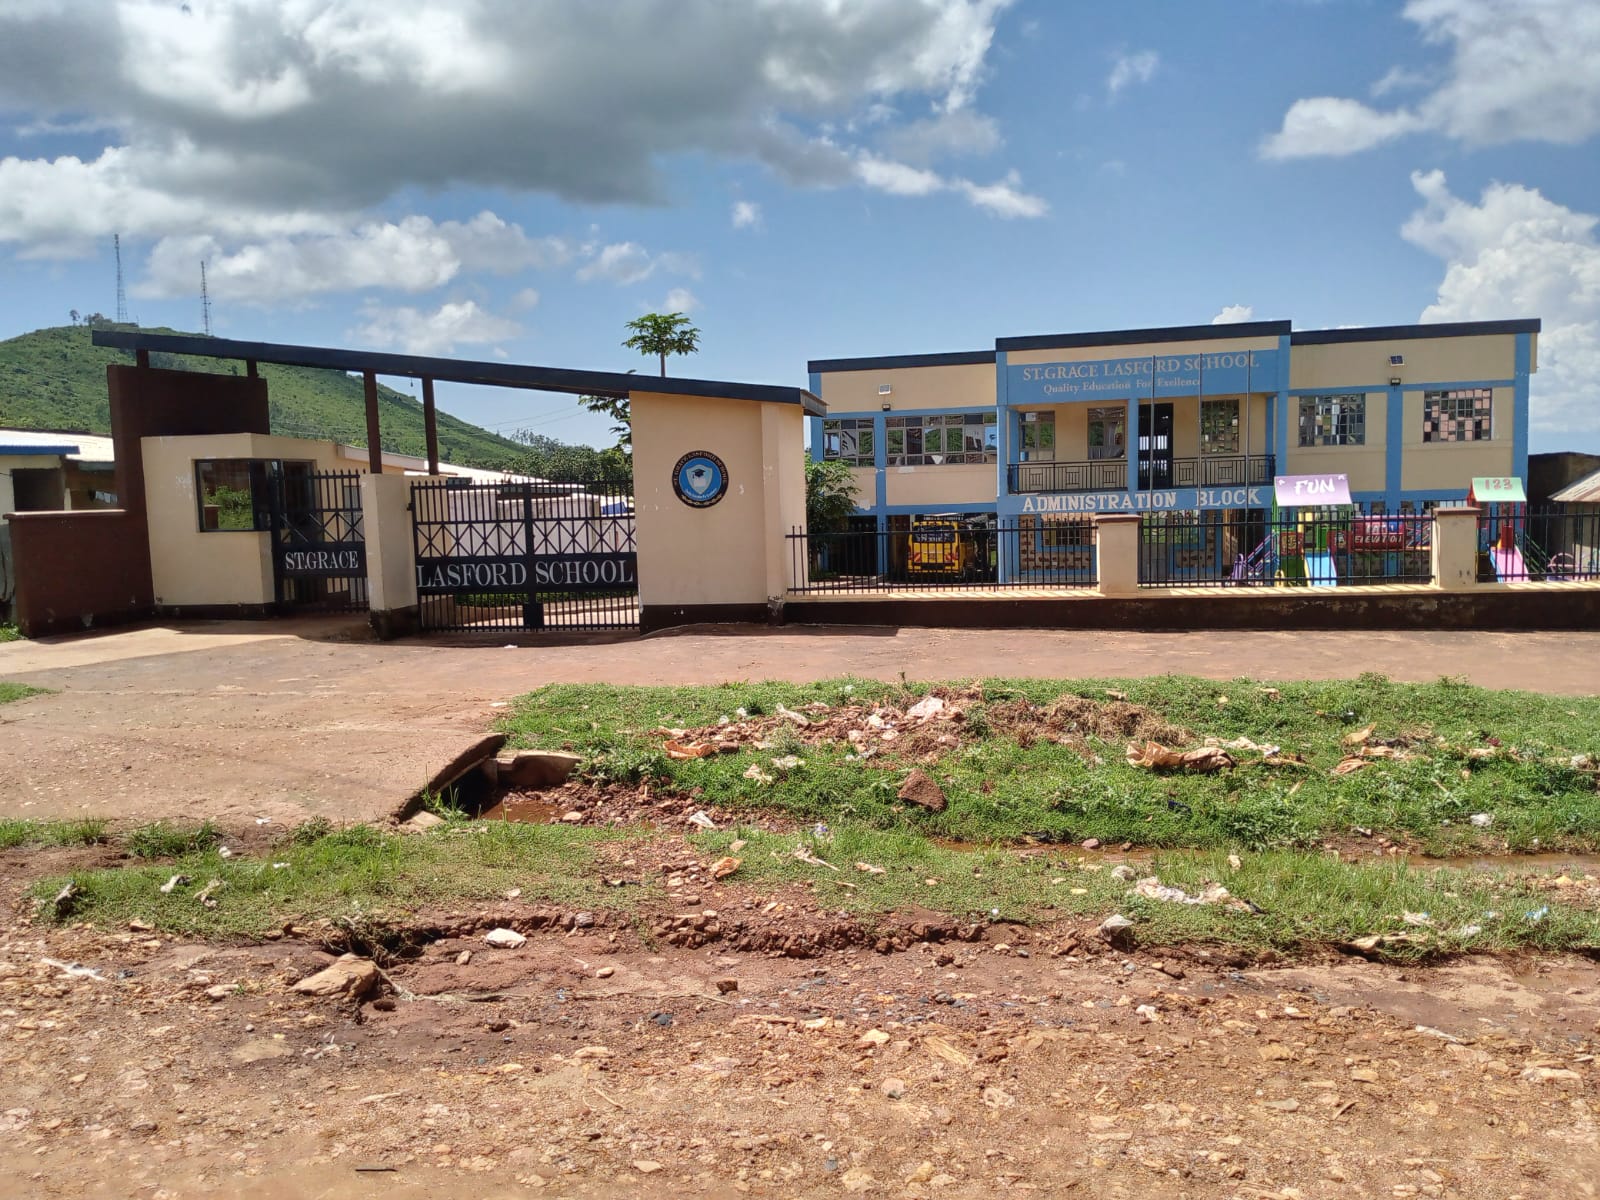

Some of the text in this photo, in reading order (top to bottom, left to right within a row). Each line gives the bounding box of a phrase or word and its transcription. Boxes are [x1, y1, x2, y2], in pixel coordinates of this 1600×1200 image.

[1023, 353, 1259, 381] ST.GRACE LASFORD SCHOOL
[1043, 383, 1079, 395] Quality
[1082, 381, 1130, 391] Education
[1295, 478, 1335, 494] FUN
[1023, 488, 1262, 513] ADMINISTRATION BLOCK
[285, 550, 359, 570] ST.GRACE
[416, 560, 634, 588] LASFORD SCHOOL
